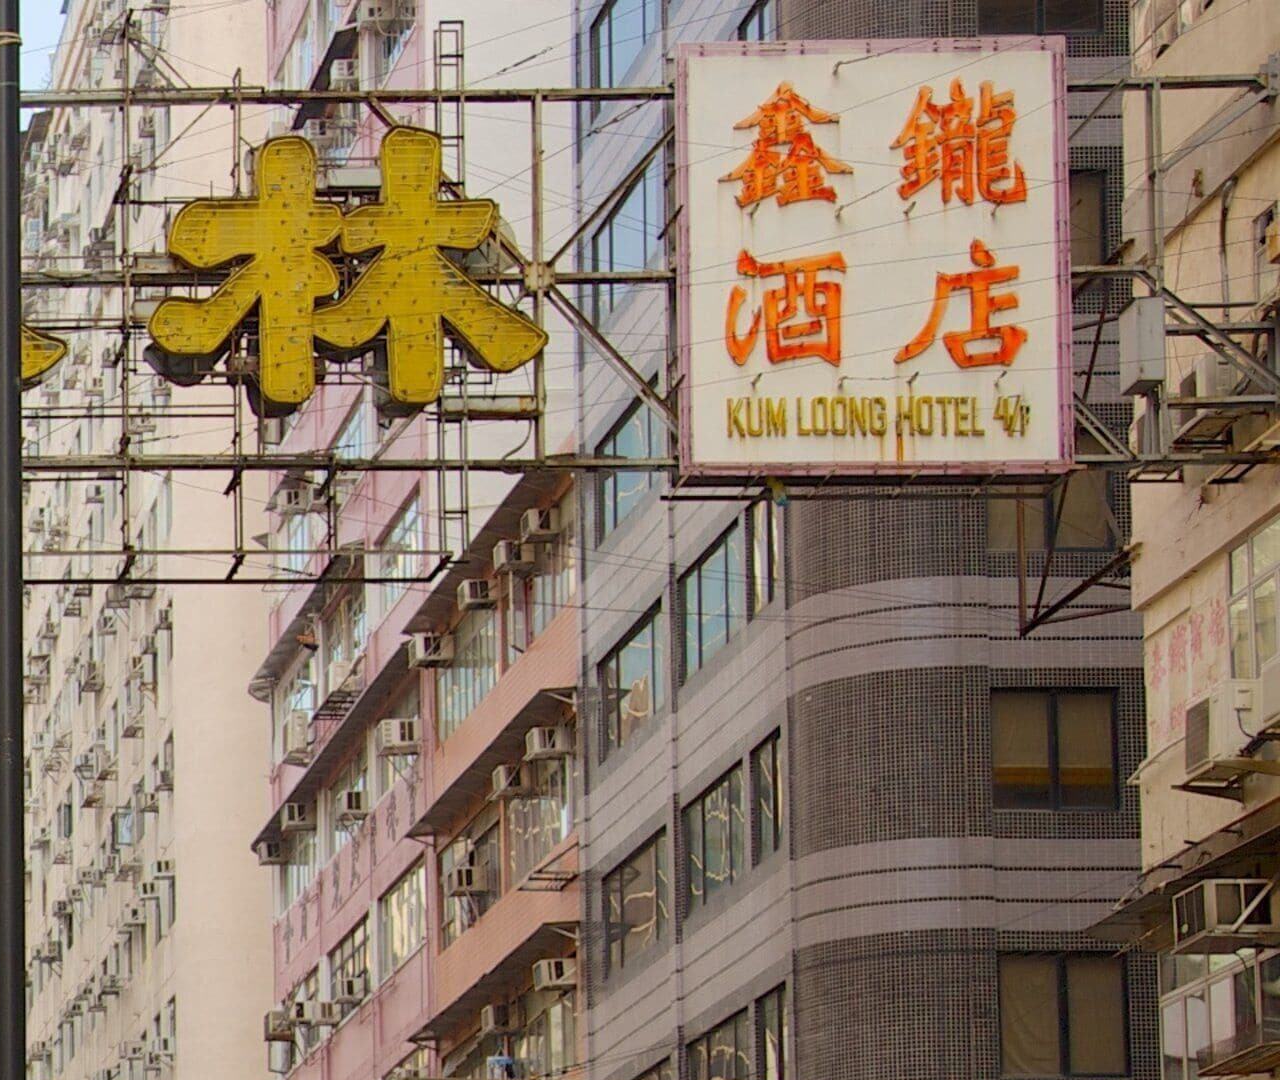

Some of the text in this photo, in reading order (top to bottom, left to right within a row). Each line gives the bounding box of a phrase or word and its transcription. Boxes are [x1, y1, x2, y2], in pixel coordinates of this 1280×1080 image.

[726, 238, 1028, 368] 酒店
[726, 396, 788, 437] KUM
[796, 396, 887, 437] LOONG
[898, 397, 985, 437] HOTEL
